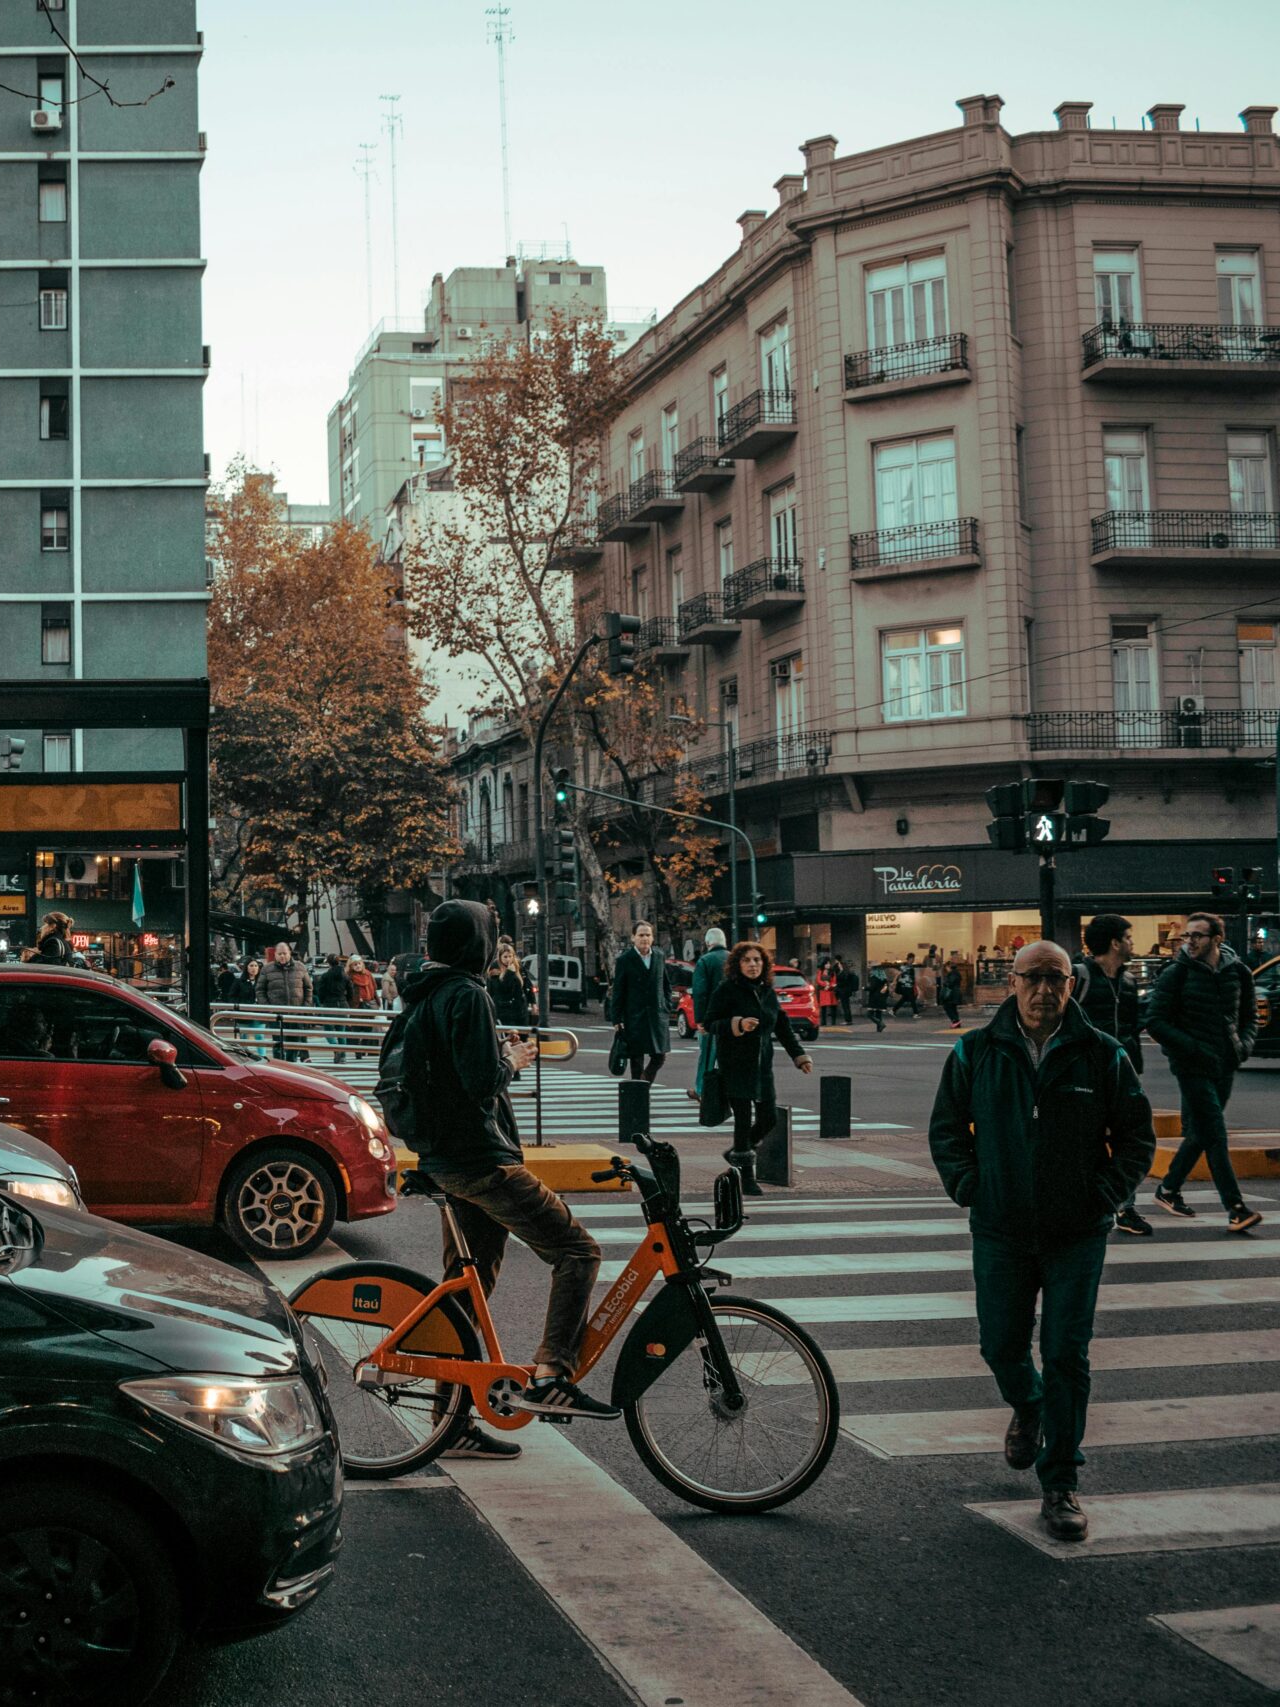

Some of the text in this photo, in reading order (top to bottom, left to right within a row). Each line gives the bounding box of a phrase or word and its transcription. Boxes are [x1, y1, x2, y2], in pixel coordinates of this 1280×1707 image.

[873, 866, 961, 894] Panadería
[73, 935, 89, 947] OPEN
[604, 1268, 640, 1313] Ecobici
[354, 1297, 379, 1309] Itaú
